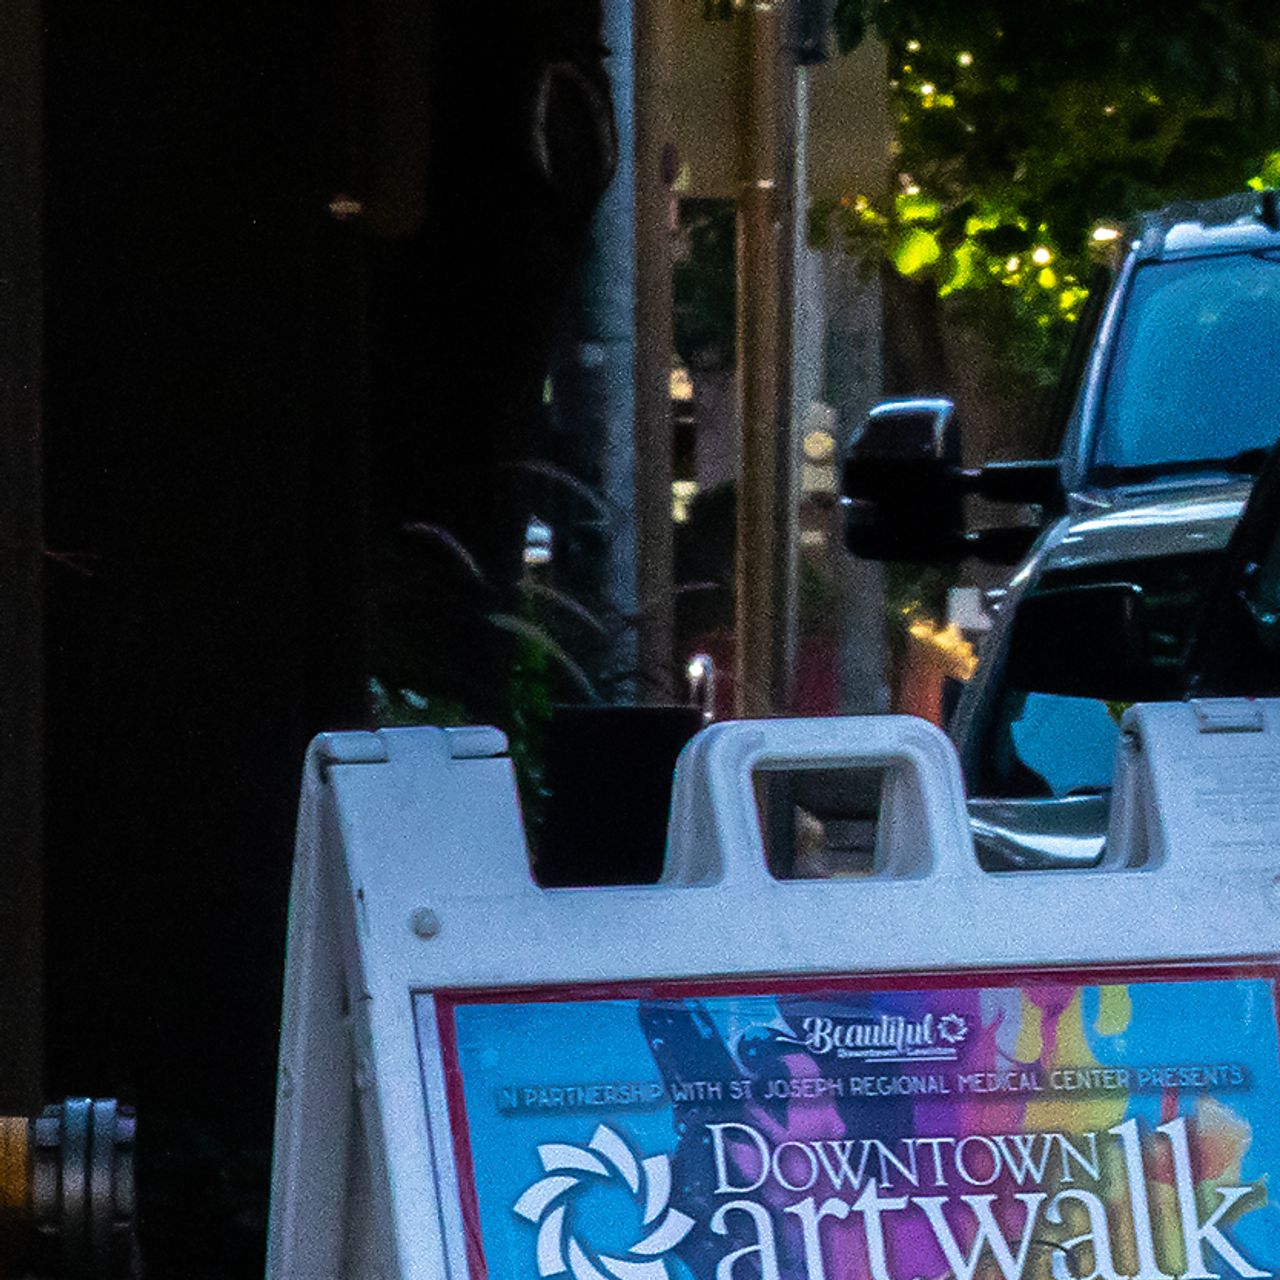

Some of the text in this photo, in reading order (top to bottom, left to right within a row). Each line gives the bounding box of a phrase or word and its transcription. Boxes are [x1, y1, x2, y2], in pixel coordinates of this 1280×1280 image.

[801, 1013, 934, 1055] Beautiful
[523, 1083, 664, 1107] PARTNERSHP
[672, 1081, 722, 1101] WITH
[729, 1080, 752, 1099] ST
[764, 1077, 844, 1099] JOSEPH
[852, 1075, 950, 1097] REGIONAL
[958, 1072, 1044, 1093] MEDICAL
[1050, 1069, 1130, 1090] CENTER
[1137, 1065, 1244, 1088] PRESENTS
[706, 1124, 1100, 1194] DOWNTOWN
